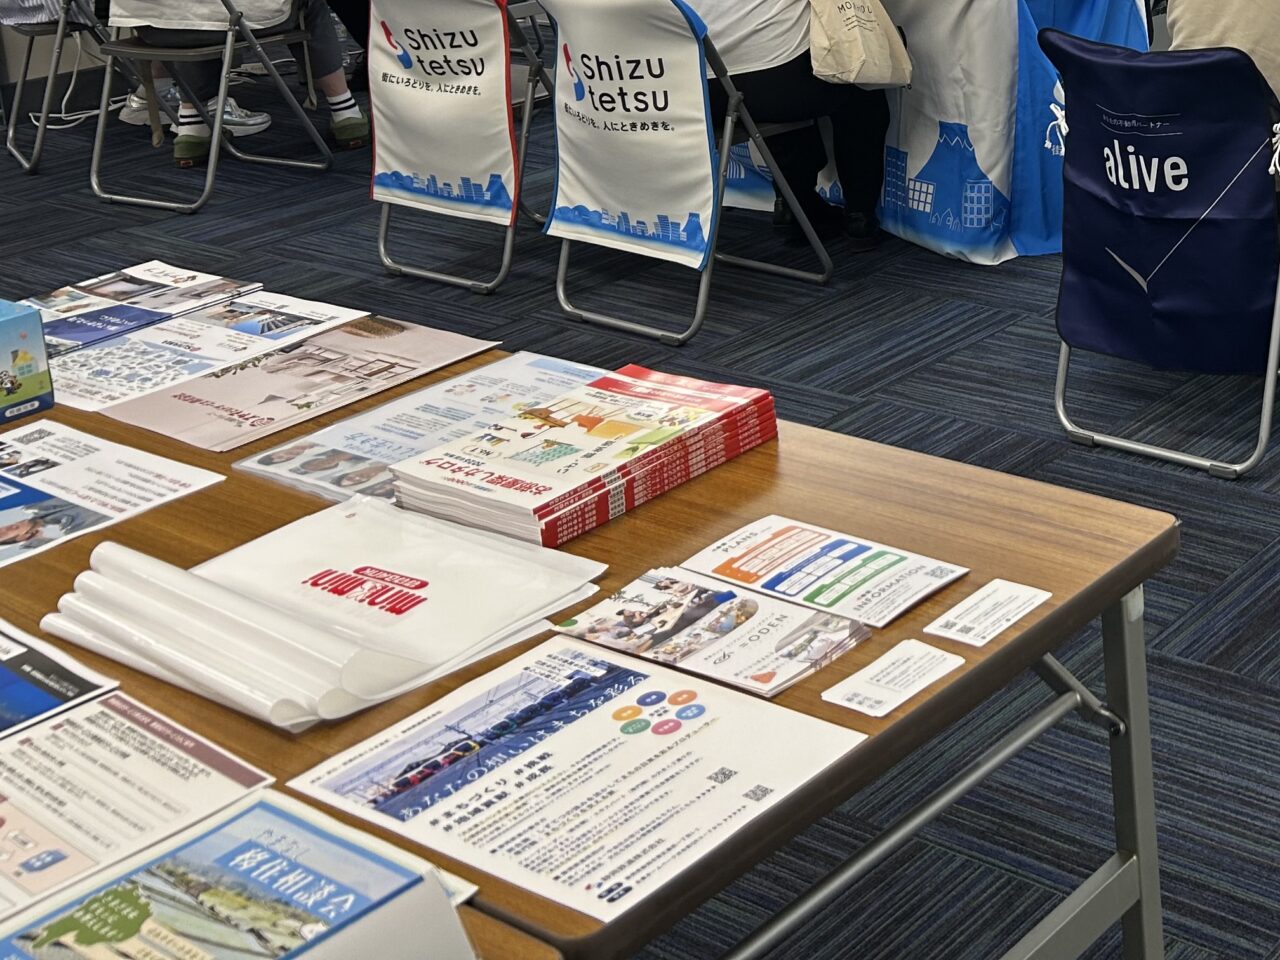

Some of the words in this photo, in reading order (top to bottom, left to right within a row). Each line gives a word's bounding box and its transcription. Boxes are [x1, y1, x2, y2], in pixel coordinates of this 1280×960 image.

[404, 27, 478, 50] Shizu
[417, 52, 485, 77] tetsu
[583, 52, 665, 81] Shizu
[588, 86, 669, 113] tetsu
[1103, 139, 1189, 193] alive
[722, 530, 760, 554] PLANS
[853, 563, 927, 614] INFORMATION
